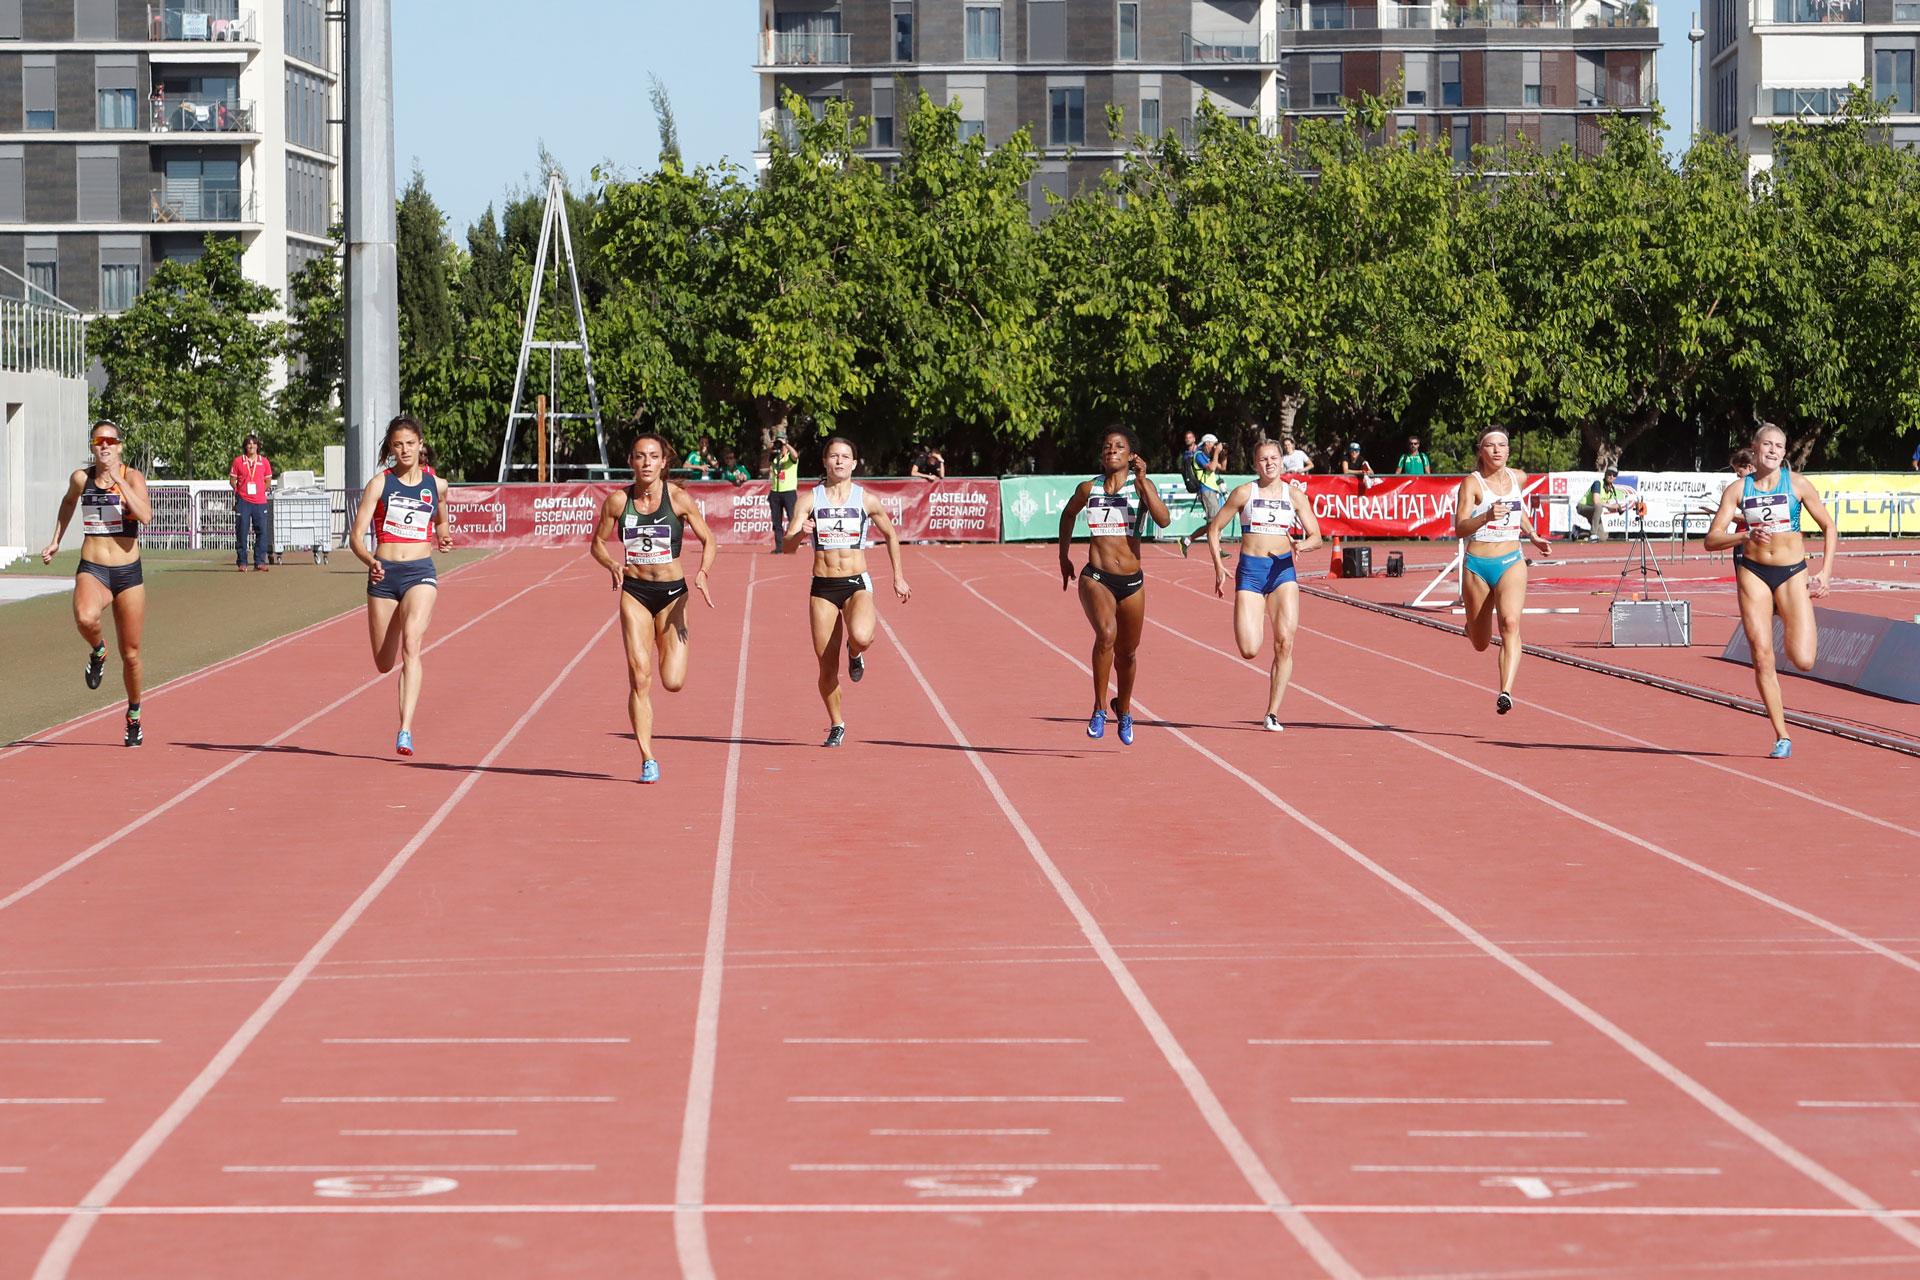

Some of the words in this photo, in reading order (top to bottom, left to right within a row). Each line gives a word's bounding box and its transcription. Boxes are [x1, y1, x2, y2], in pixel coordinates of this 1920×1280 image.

[1640, 481, 1662, 492] PLAYAS
[1664, 481, 1672, 492] DE
[534, 495, 597, 509] CASTELLÓN,
[929, 490, 989, 505] CASTELLÓN,
[96, 507, 102, 520] 1
[448, 503, 503, 513] DIPUTACIÓ
[930, 506, 986, 517] ESCENARIO
[1313, 494, 1427, 520] GENERALITAT
[403, 511, 415, 525] 6
[534, 510, 594, 523] ESCENARIO
[1102, 508, 1110, 522] 7
[1267, 511, 1276, 523] 5
[1503, 512, 1511, 526] 3
[1761, 507, 1772, 521] 2
[534, 523, 593, 536] DEPORTIVO
[833, 519, 844, 532] 4
[929, 518, 985, 530] DEPORTIVO
[642, 538, 653, 552] 8
